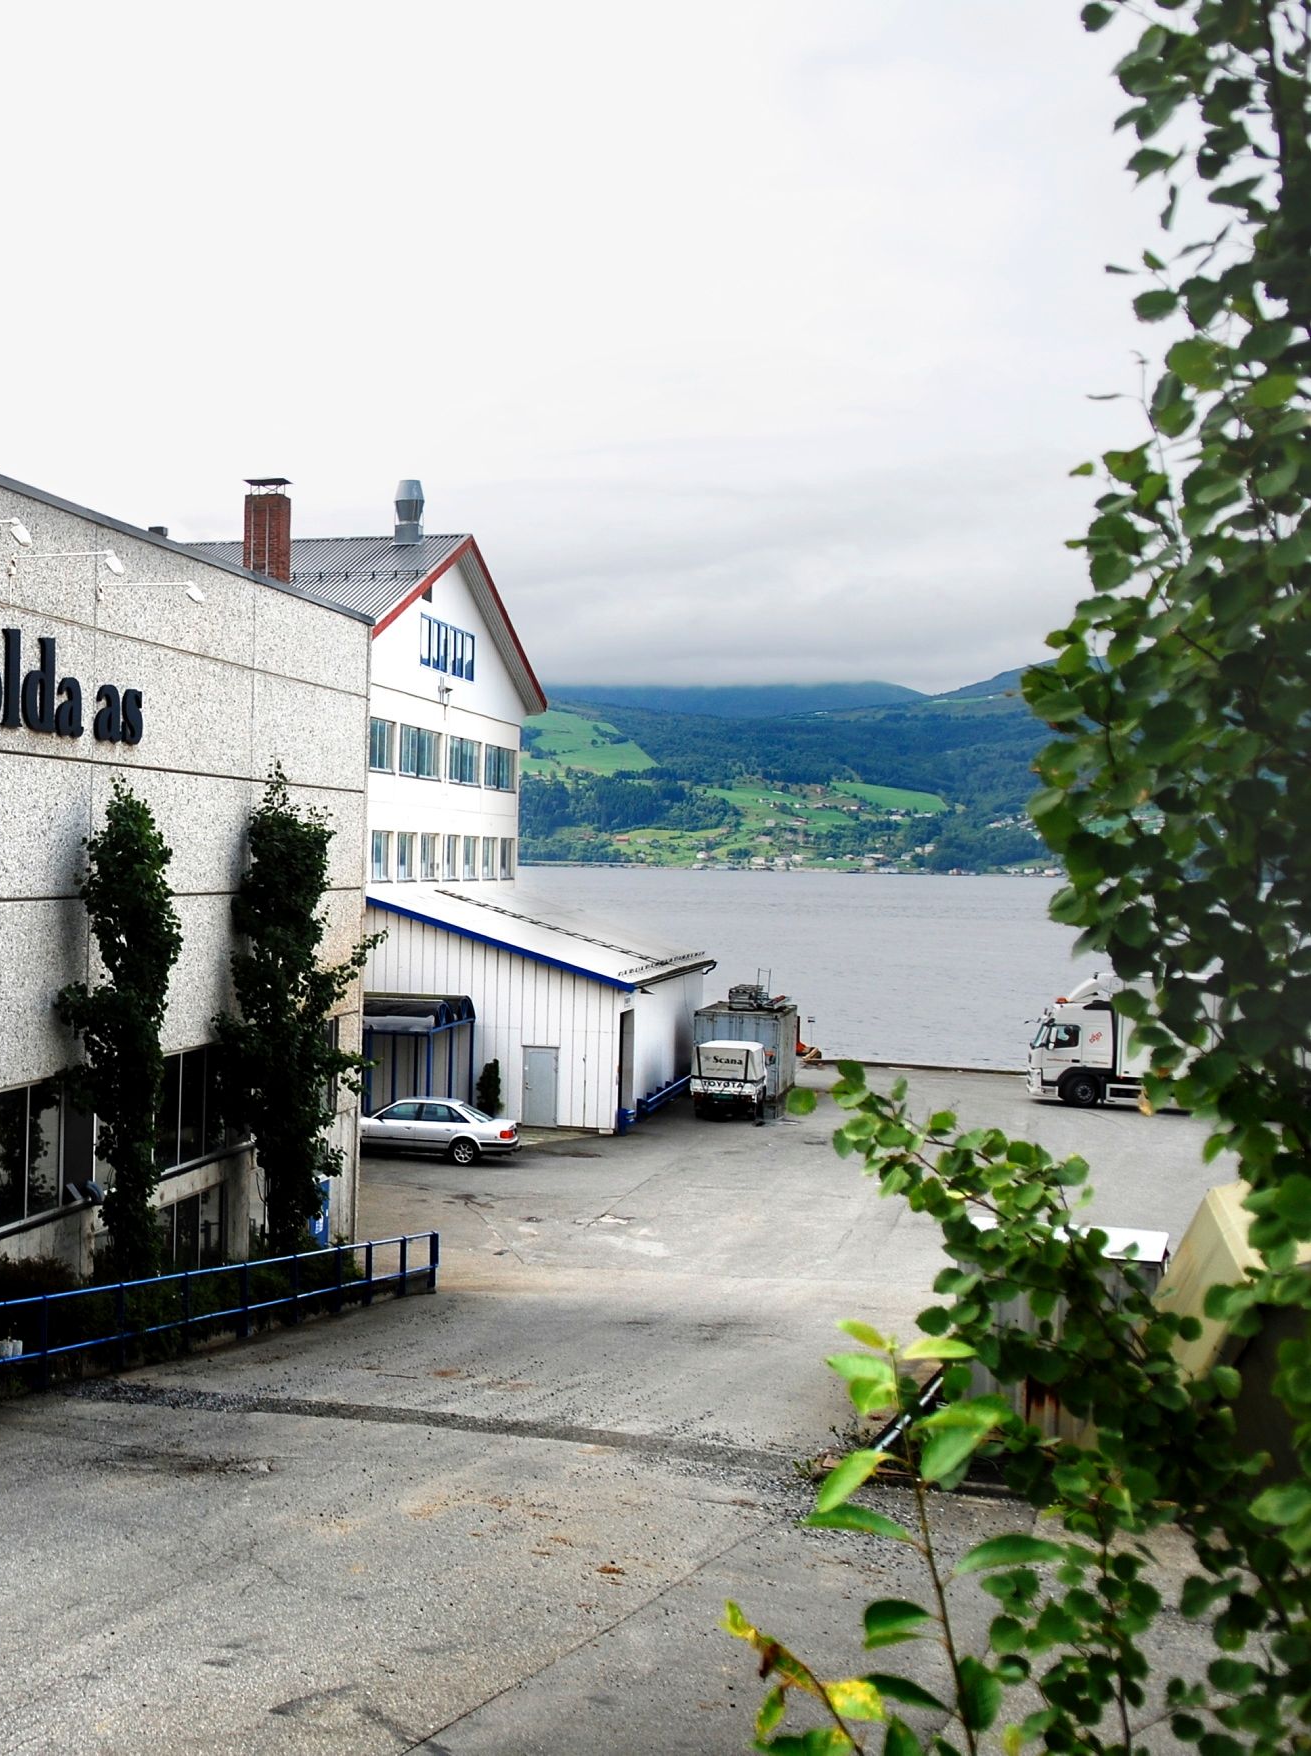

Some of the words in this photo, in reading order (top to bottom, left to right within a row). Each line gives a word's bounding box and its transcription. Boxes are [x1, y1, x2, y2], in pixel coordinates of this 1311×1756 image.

[94, 684, 144, 745] as
[712, 1055, 743, 1065] Scana
[703, 1080, 745, 1088] TOYOTA
